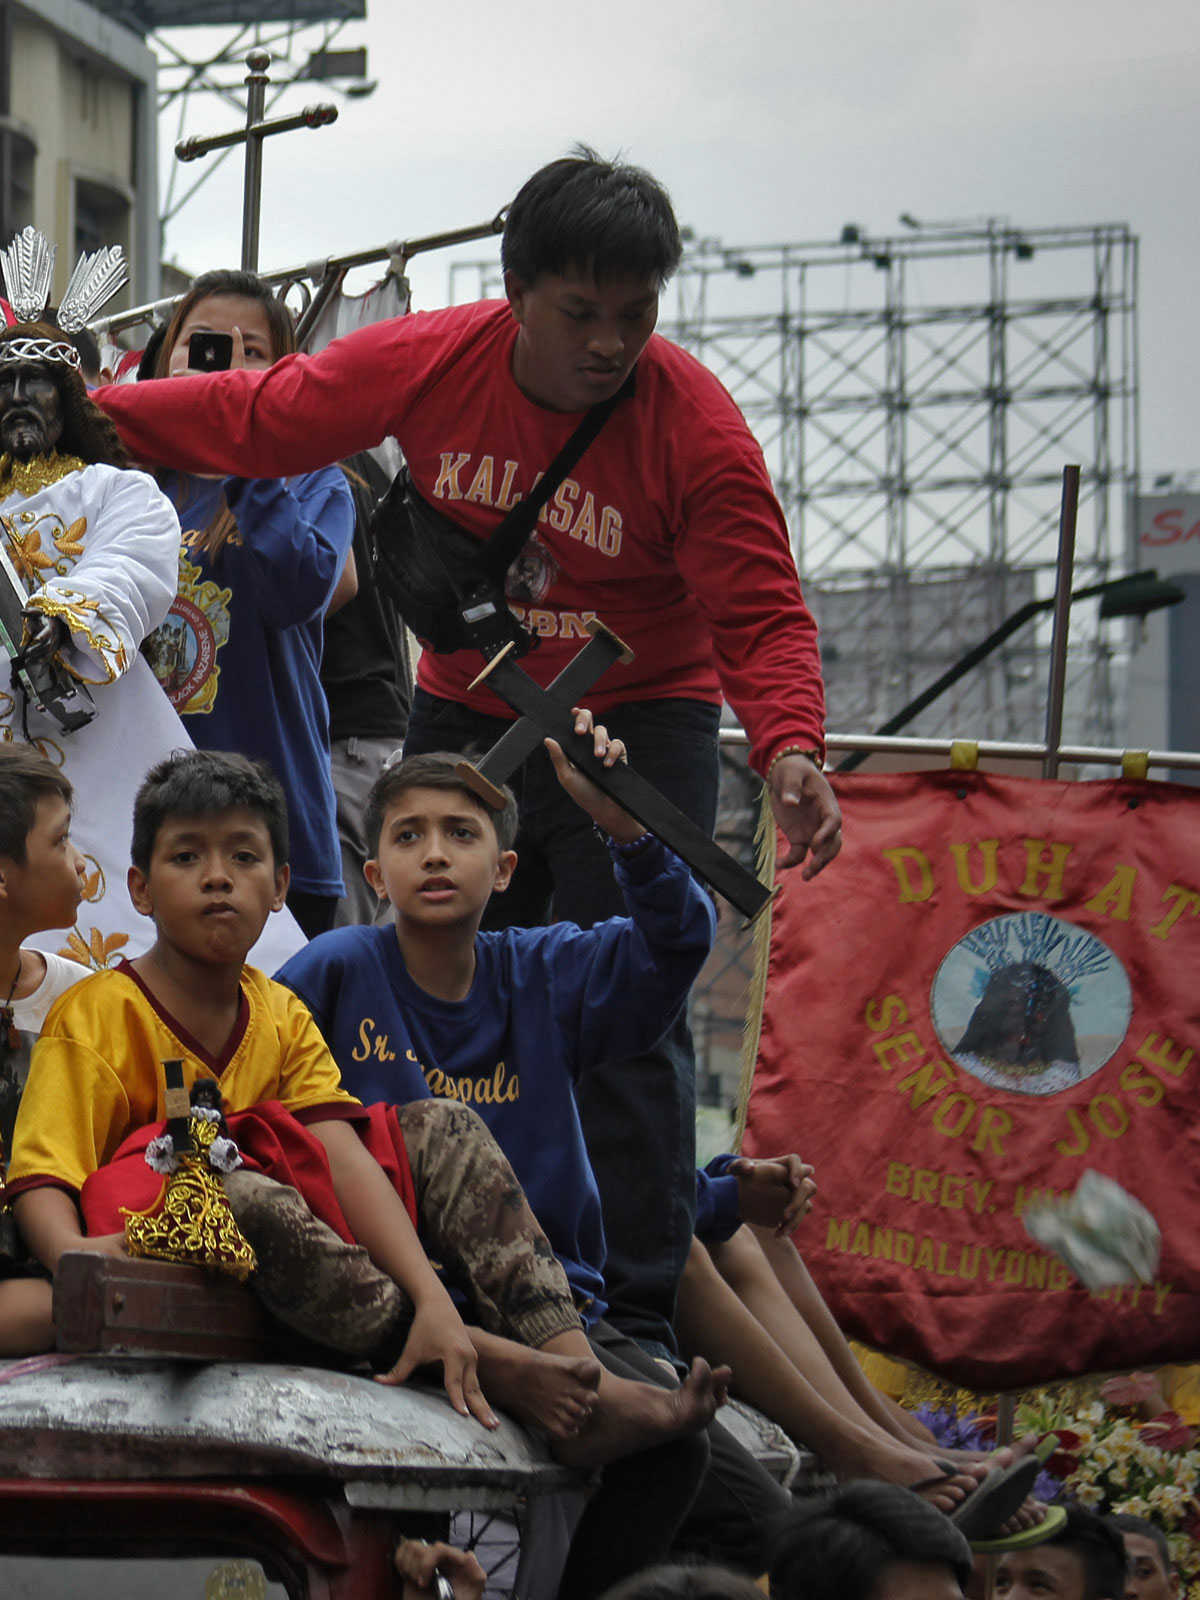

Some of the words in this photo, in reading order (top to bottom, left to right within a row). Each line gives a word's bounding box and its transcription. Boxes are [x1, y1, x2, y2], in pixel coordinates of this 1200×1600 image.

[192, 628, 211, 683] NAZARENE
[882, 838, 1200, 941] DUHAT
[352, 1018, 396, 1062] Sr.
[1055, 1031, 1195, 1157] JOSE
[886, 1160, 997, 1214] BRGY.
[825, 1216, 1068, 1292] MANDALUYONG
